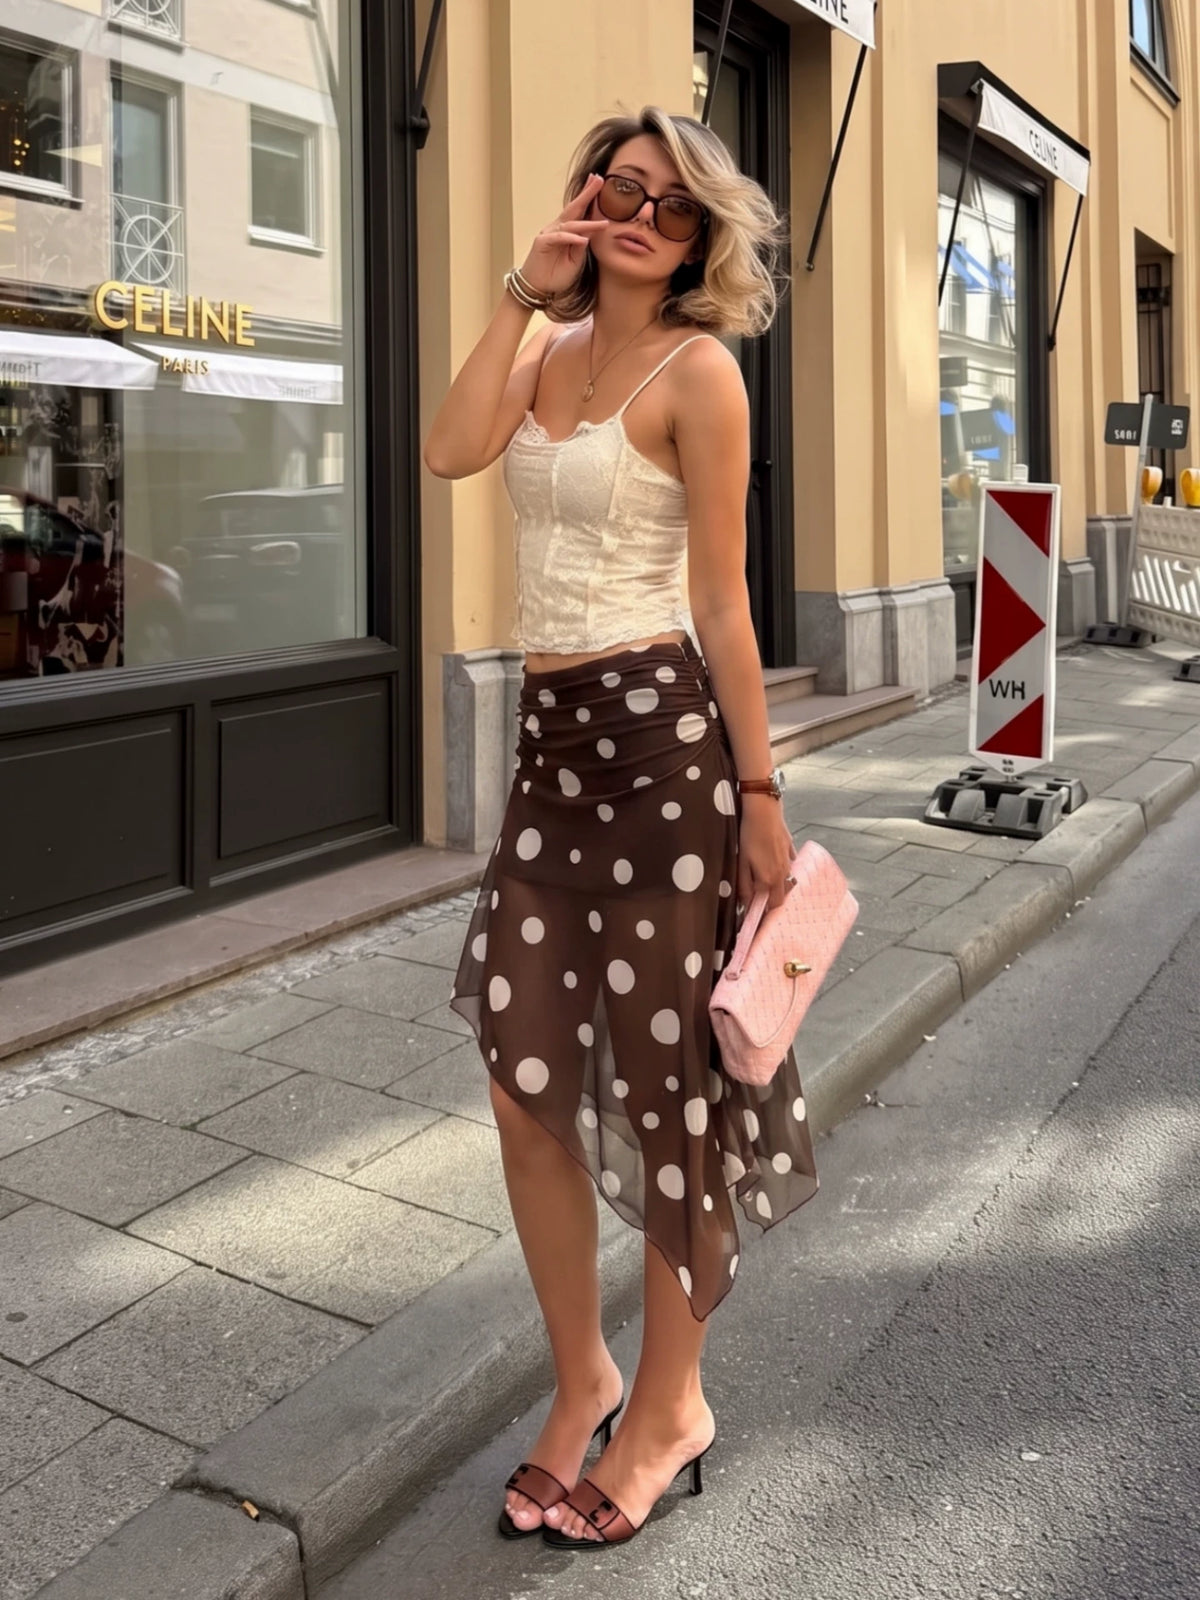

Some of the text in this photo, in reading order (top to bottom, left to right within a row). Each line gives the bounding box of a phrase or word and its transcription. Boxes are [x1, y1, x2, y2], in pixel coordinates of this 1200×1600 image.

[95, 280, 255, 347] CELINE
[161, 356, 209, 376] PARIS
[988, 678, 1026, 701] WH
